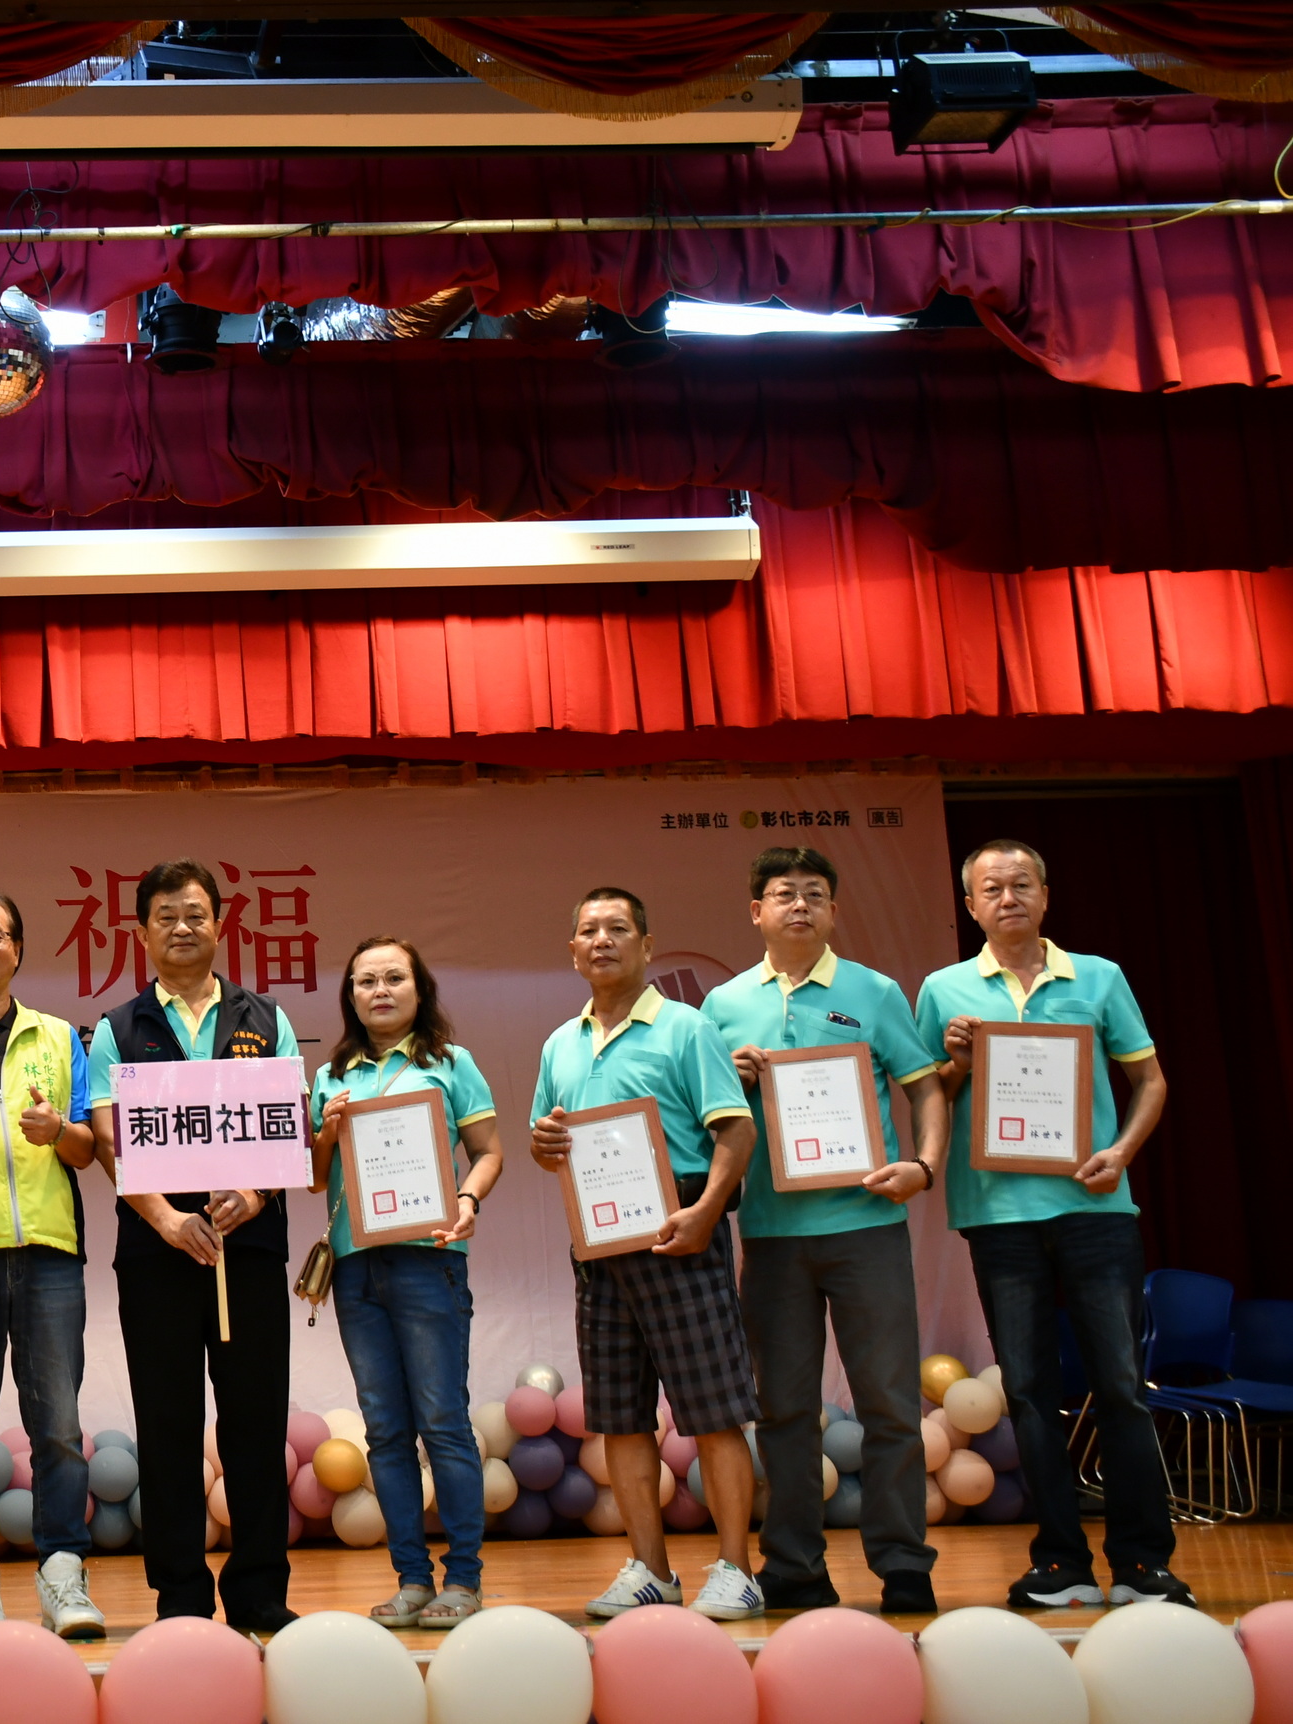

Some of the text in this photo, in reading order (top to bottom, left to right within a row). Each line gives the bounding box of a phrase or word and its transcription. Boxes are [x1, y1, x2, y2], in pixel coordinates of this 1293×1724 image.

[660, 810, 900, 829] 主辦單位 彰化市公所 廣告
[55, 861, 320, 999] 祝福
[42, 1052, 55, 1103] 彰化市長
[120, 1066, 136, 1079] 23
[128, 1102, 298, 1147] 莿桐社區
[1030, 1130, 1063, 1140] 林世賢
[826, 1145, 857, 1155] 林世賢
[402, 1196, 431, 1207] 林世賢
[623, 1206, 653, 1218] 林世賢
